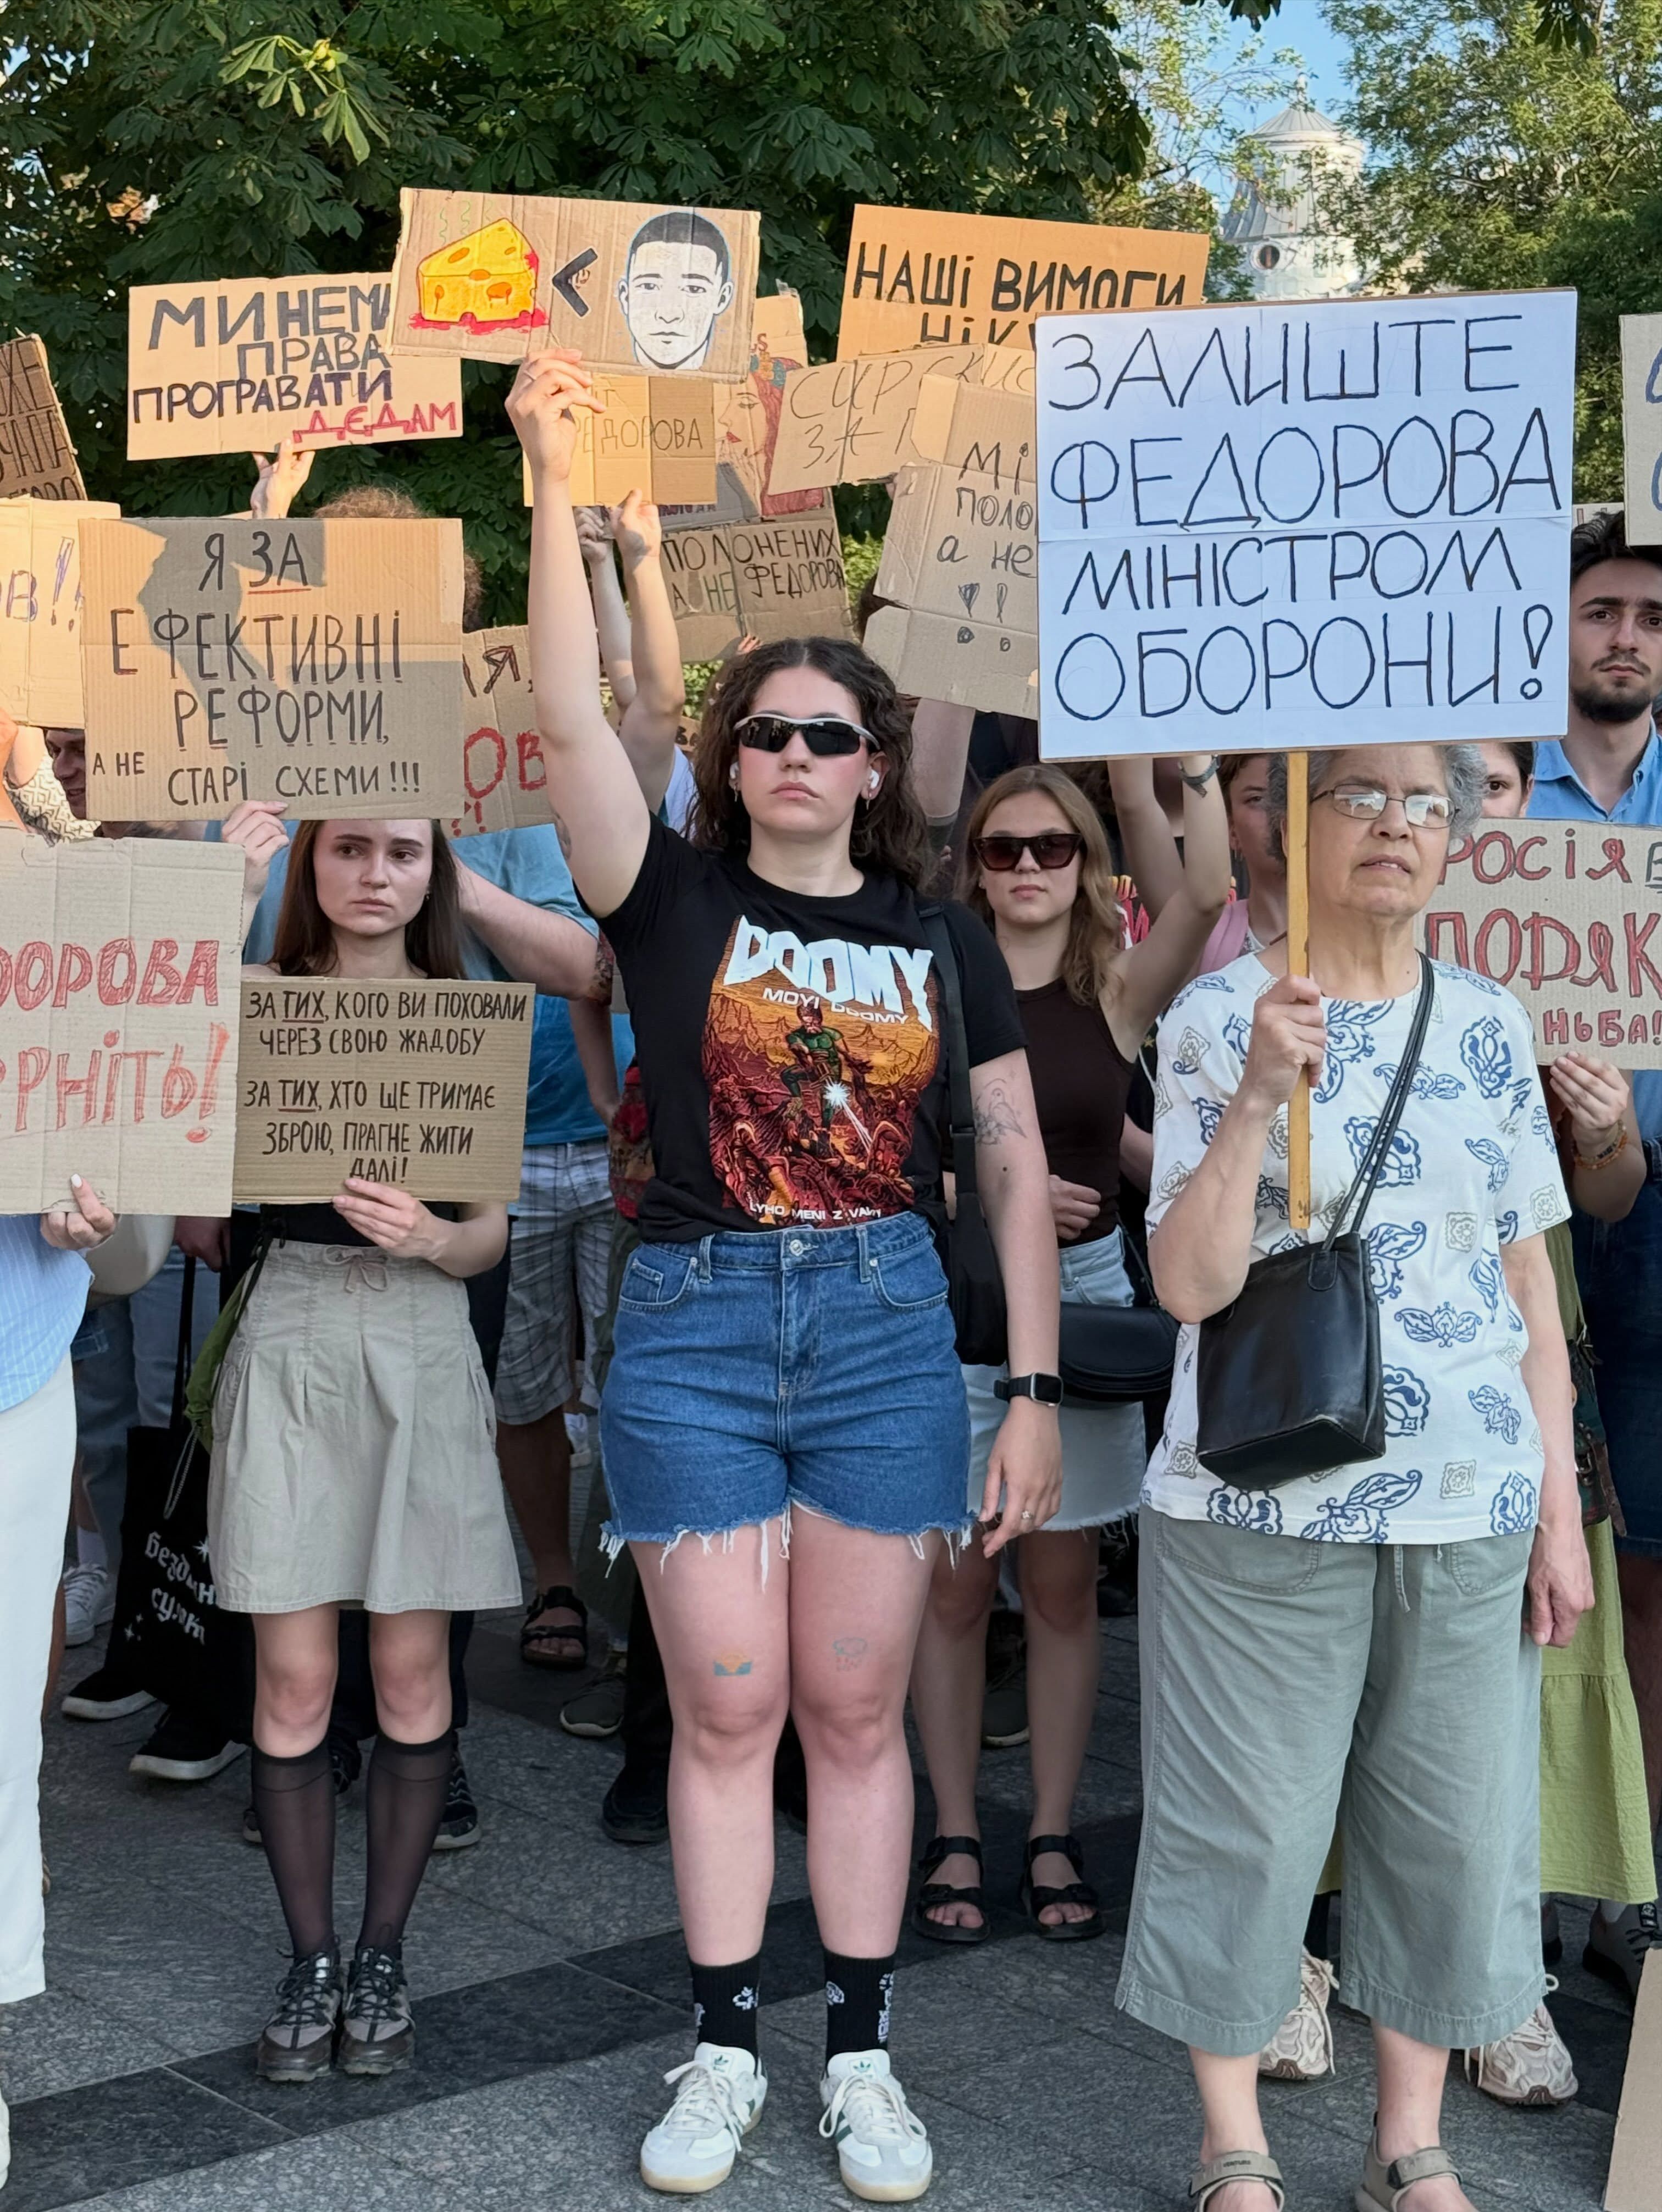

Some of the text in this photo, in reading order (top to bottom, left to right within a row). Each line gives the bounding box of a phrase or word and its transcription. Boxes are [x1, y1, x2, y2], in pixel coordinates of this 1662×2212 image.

[853, 242, 1185, 312] НАШІ ВИМОГИ
[237, 332, 392, 380] ПРАВА
[1048, 315, 1522, 410] ЗАЛИШТЕ
[133, 369, 393, 424] ПРОГРАВАТИ
[1050, 407, 1562, 532] ФЕДОРОВА
[198, 531, 309, 592] Я ЗА
[661, 528, 841, 573] ПОЛОНЕНИХ
[1062, 526, 1522, 615] МІНІСТРОМ
[672, 558, 846, 613] А НЕ ФЕДОРОВА
[1055, 605, 1553, 721] ОБОРОНИ!
[174, 685, 389, 751] РЕФОРМИ,
[93, 753, 106, 775] А
[116, 752, 145, 775] НЕ
[168, 762, 248, 806] СТАРІ
[1437, 828, 1632, 885] РОСІЯ
[723, 914, 934, 1033] DOOMY
[762, 987, 821, 1010] MOYI
[245, 990, 528, 1022] ЗА ТИХ, КОГО ВИ ПОХОВАЛИ
[1527, 1007, 1662, 1047] НЬБА!
[259, 1027, 486, 1056] ЧЕРЕЗ СВОЮ ЖАДОБУ
[0, 1021, 231, 1143] РНІТЬ!
[243, 1079, 496, 1112] ЗА ТИХ, ХТО ЩЕ ТРИМАЄ
[262, 1120, 474, 1156] ЗБРОЮ, ПРАГНЕ ЖИТИ
[349, 1155, 409, 1184] ДАЛІ!
[749, 1200, 785, 1216] LYHO
[792, 1209, 827, 1220] MENI
[833, 1211, 843, 1220] Z
